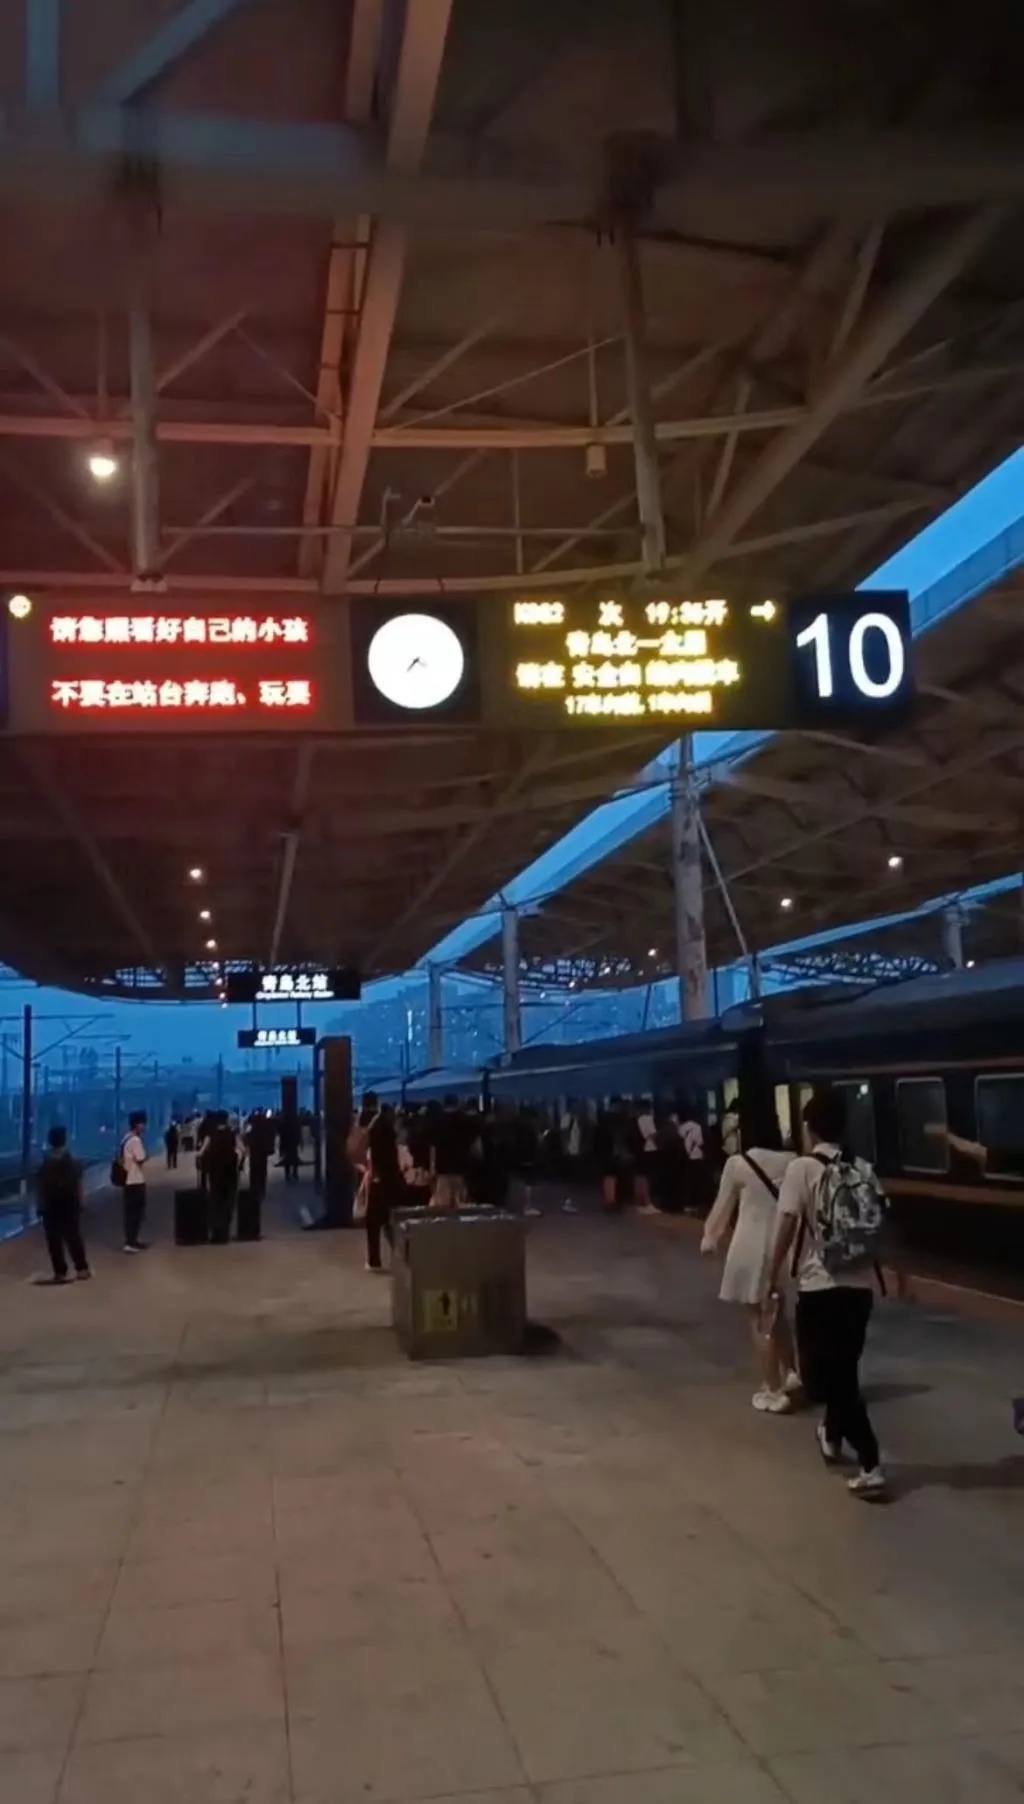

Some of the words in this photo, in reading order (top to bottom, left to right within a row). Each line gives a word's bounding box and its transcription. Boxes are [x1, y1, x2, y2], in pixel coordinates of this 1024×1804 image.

[598, 601, 624, 626] 次
[50, 616, 309, 643] 请您照看好自己的小孩
[796, 612, 904, 698] 10
[262, 974, 328, 991] 青岛北站
